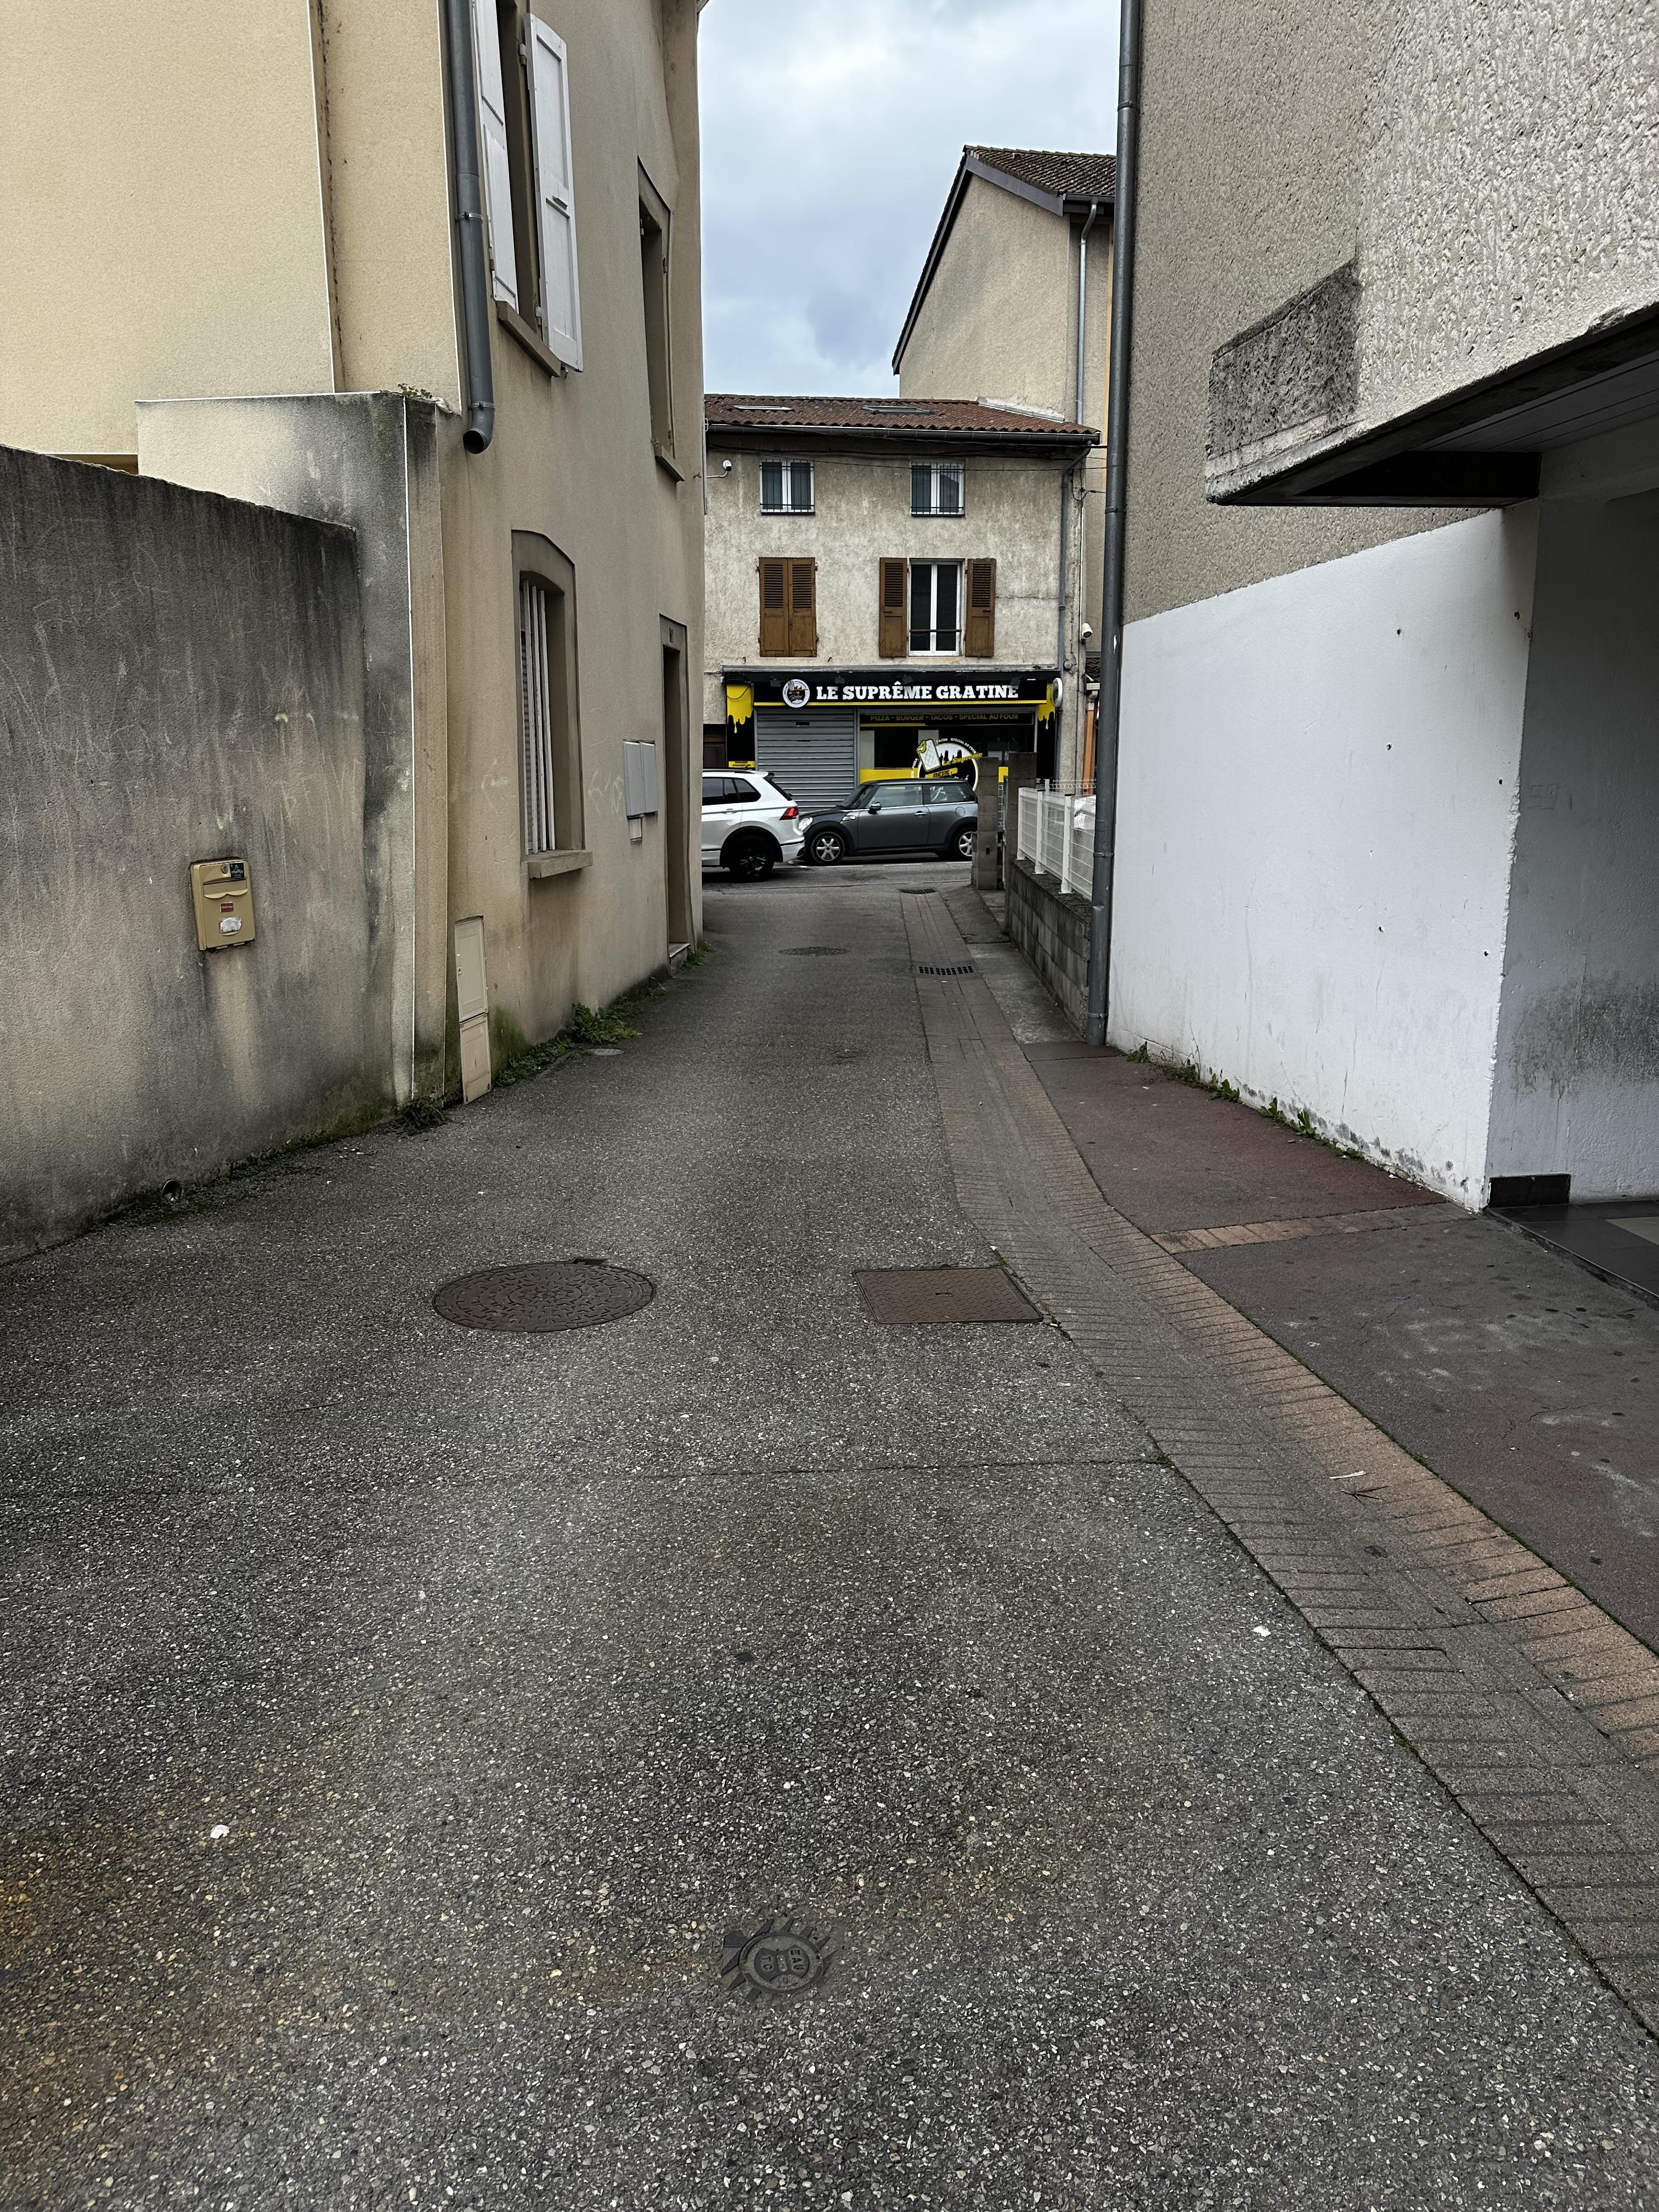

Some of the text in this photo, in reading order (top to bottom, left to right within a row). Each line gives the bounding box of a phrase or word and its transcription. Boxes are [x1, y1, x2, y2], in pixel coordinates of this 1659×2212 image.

[816, 686, 838, 700] LE
[842, 681, 932, 700] SUPRÊME
[935, 685, 1019, 699] GRATINE
[789, 1949, 804, 1971] EAU
